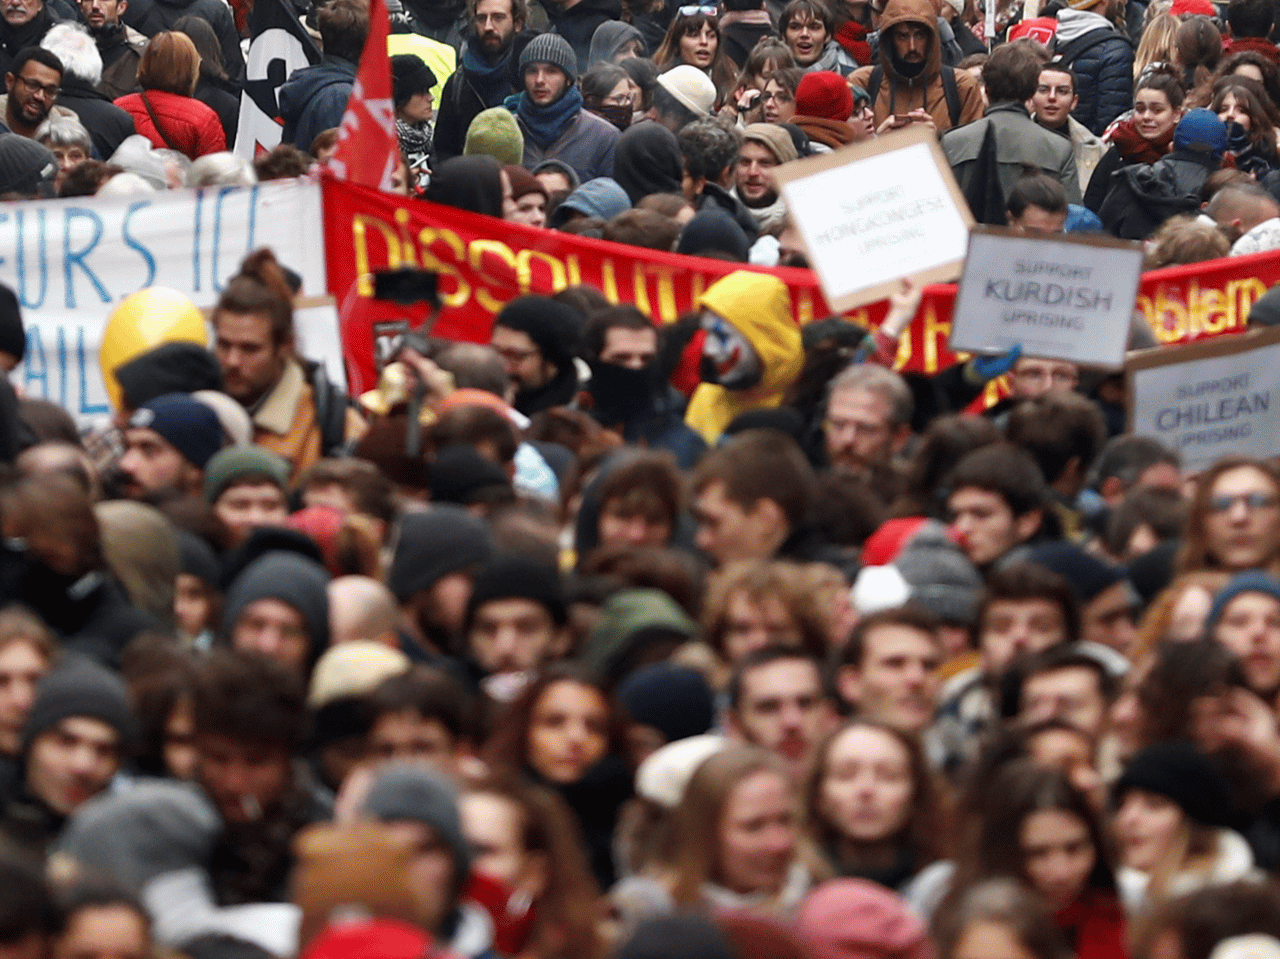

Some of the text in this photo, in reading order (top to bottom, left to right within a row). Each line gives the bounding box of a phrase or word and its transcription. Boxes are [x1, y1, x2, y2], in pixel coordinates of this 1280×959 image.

[1014, 258, 1094, 280] SUPPORT
[982, 277, 1114, 313] KURDISH
[1002, 310, 1086, 331] UPRISING
[1174, 373, 1254, 400] SUPPORT
[1154, 391, 1272, 433] CHILEAN
